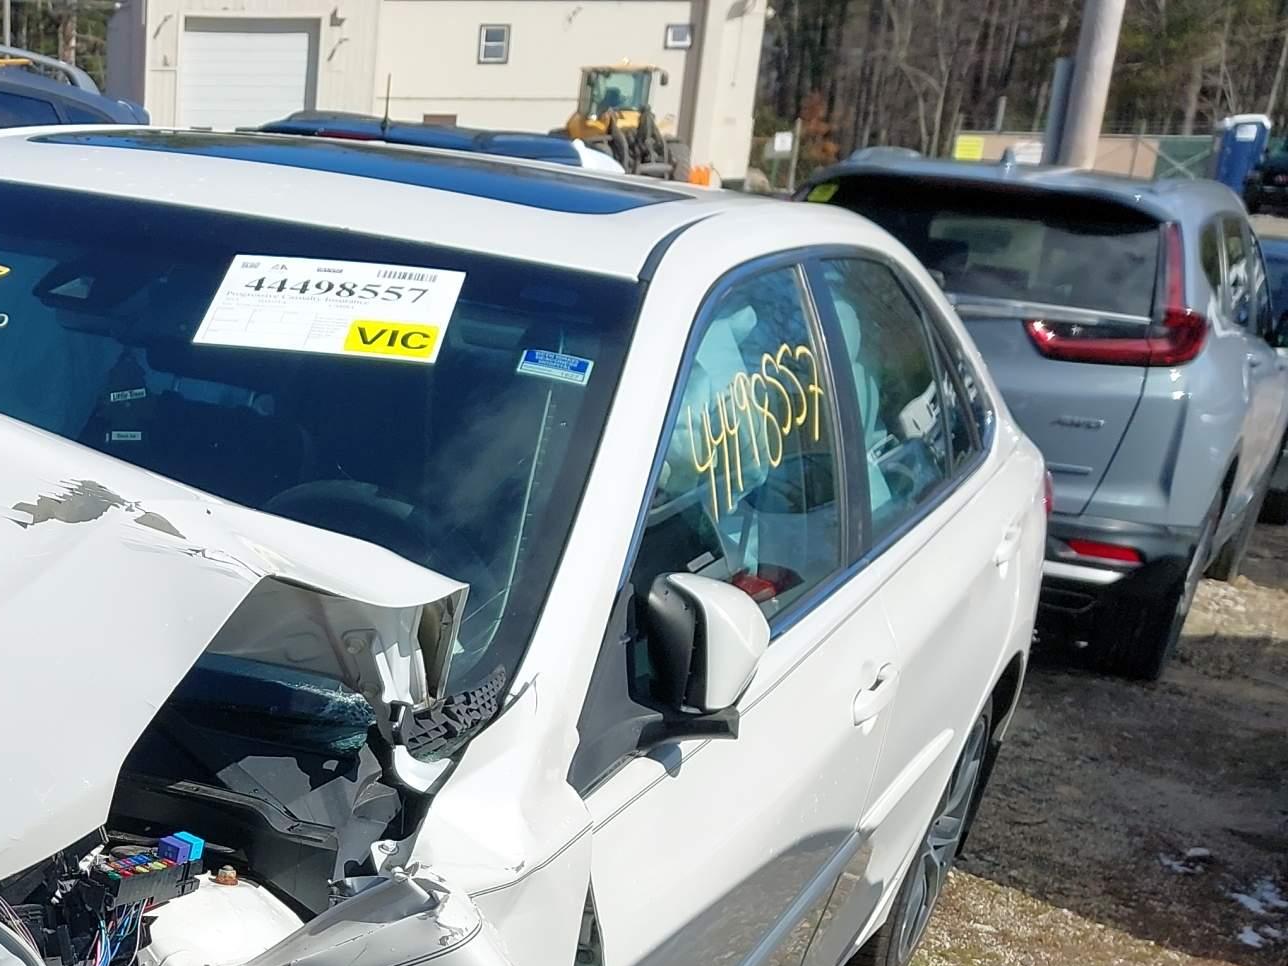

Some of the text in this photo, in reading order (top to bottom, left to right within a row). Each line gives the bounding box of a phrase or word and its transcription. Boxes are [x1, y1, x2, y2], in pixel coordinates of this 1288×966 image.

[244, 276, 430, 304] 44498557
[357, 326, 431, 350] VIC
[687, 343, 824, 523] 44498557
